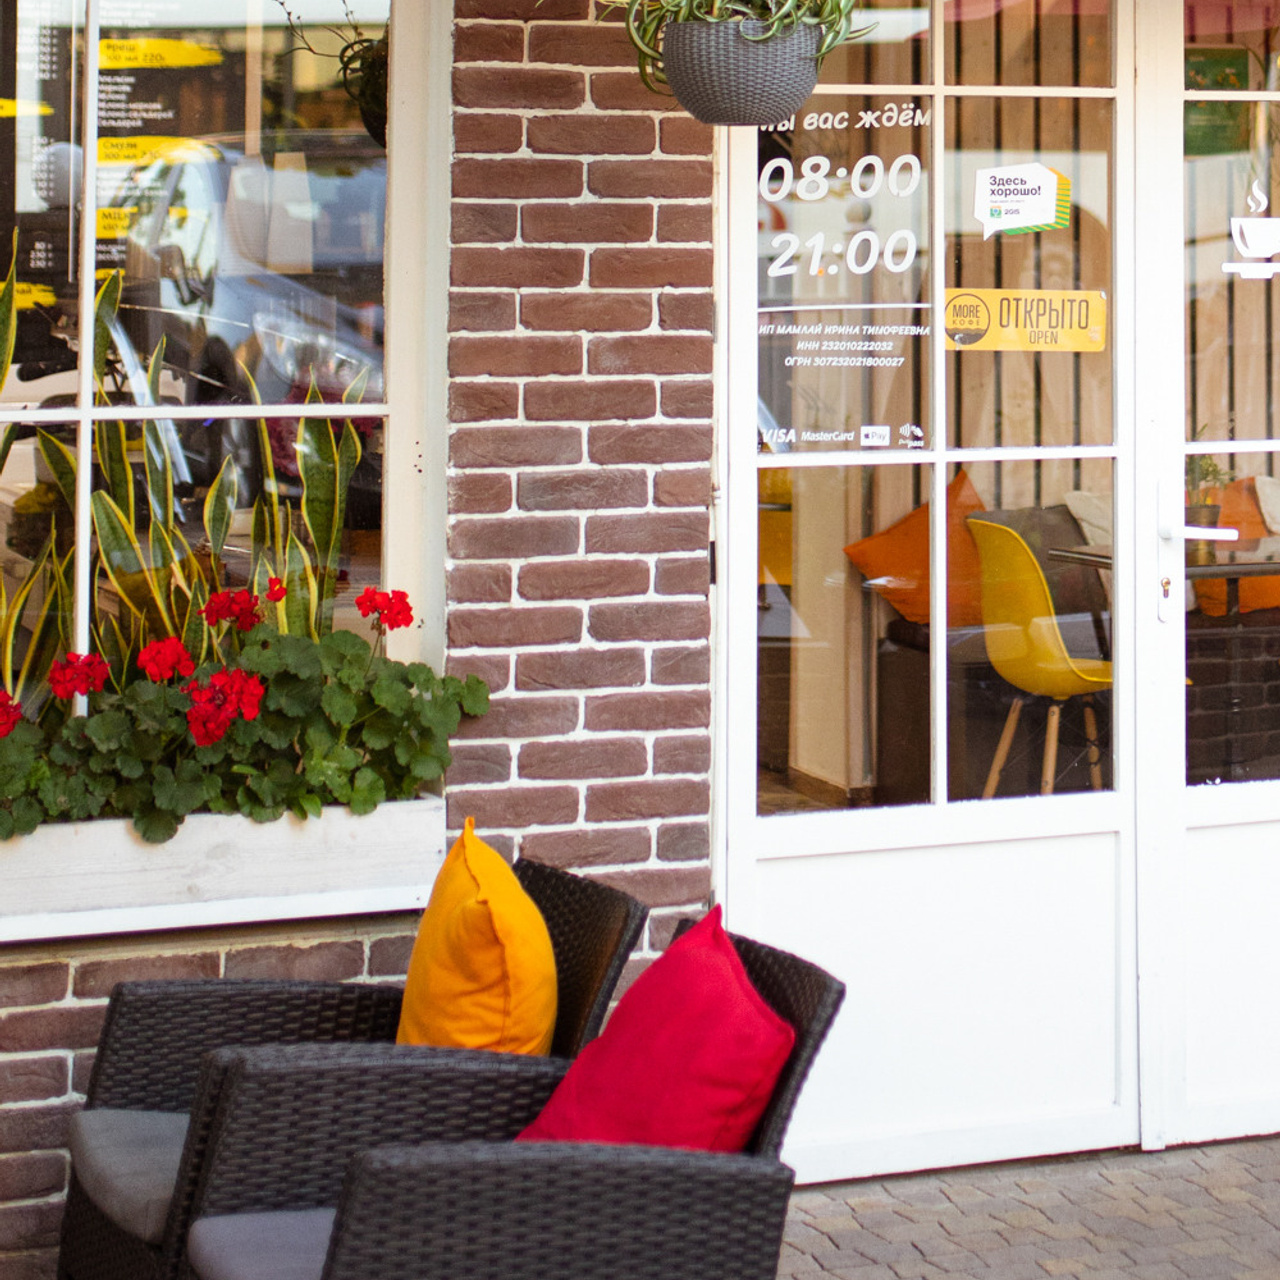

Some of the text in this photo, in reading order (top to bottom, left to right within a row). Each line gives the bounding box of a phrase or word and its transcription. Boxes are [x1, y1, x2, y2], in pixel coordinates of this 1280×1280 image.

[802, 111, 849, 130] вас
[854, 102, 932, 128] ждём
[989, 175, 1027, 187] Здесь
[989, 185, 1041, 197] хорошо!
[767, 229, 917, 277] 21:00
[952, 304, 980, 319] MORE
[999, 297, 1089, 330] ОТКРЫТО
[759, 324, 775, 334] ИП
[824, 324, 860, 335] ИРИНА
[862, 325, 932, 336] ТИМОФЕЕВНА
[1029, 330, 1059, 345] OPEN
[796, 341, 894, 351] ИНН 232010222032
[784, 356, 905, 367] ОГРН 307232021800027
[762, 429, 796, 443] VISA
[801, 431, 855, 442] MasterCard
